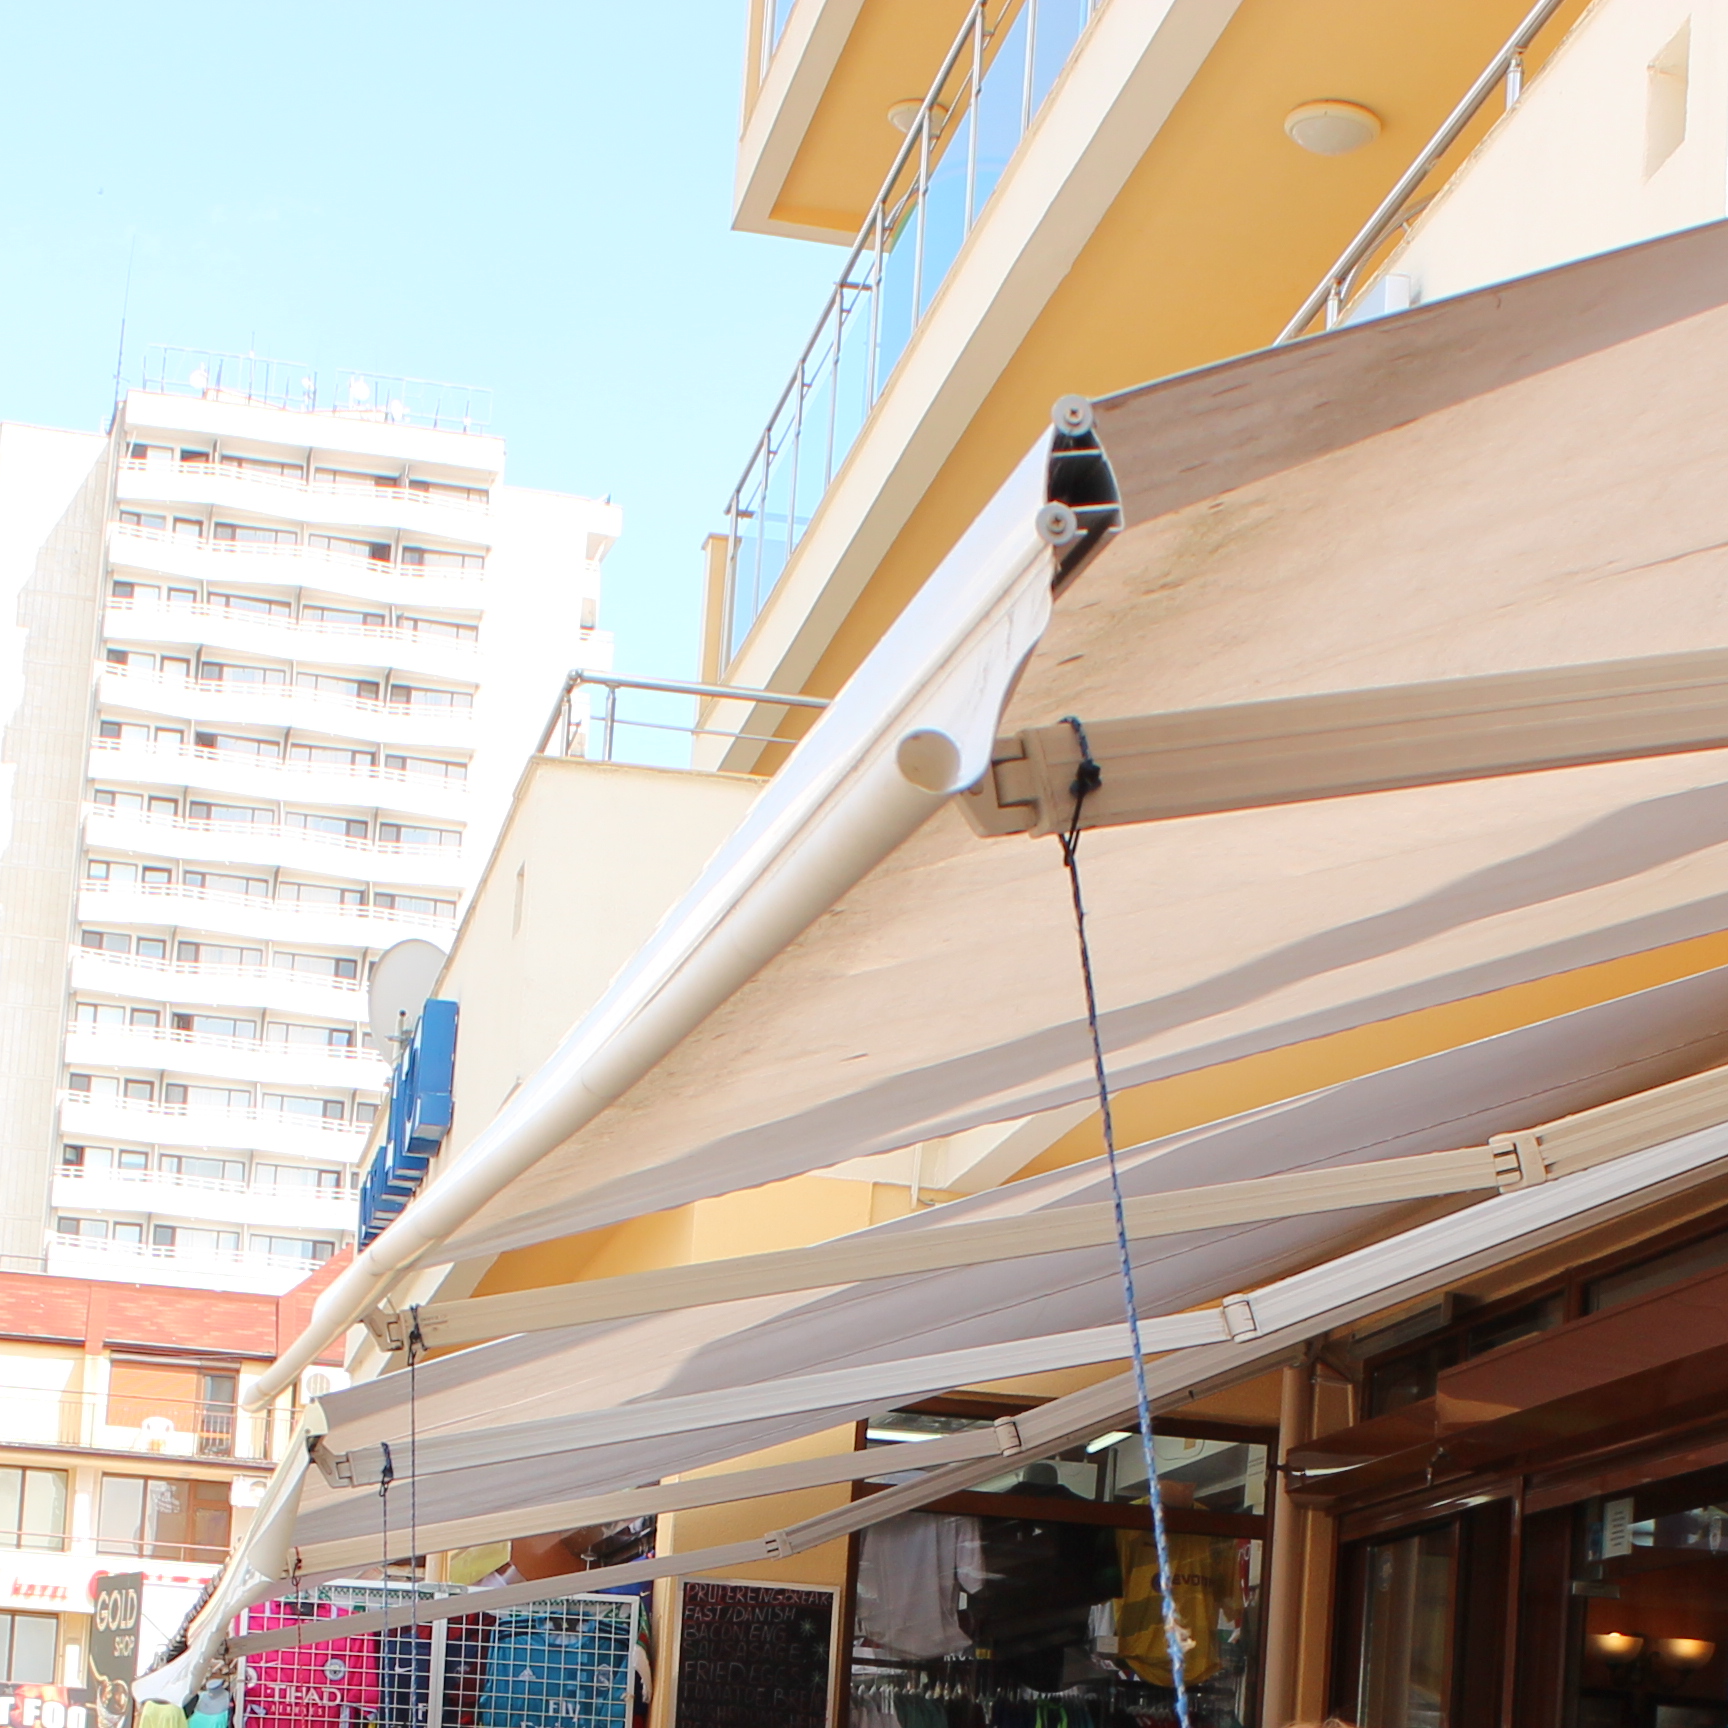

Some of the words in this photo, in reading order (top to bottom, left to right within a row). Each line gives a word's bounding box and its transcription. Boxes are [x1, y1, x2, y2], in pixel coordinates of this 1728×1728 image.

[96, 1588, 138, 1632] GOLD
[113, 1635, 135, 1656] SHOP
[268, 1684, 342, 1706] TIHAD
[548, 1699, 581, 1722] Fly
